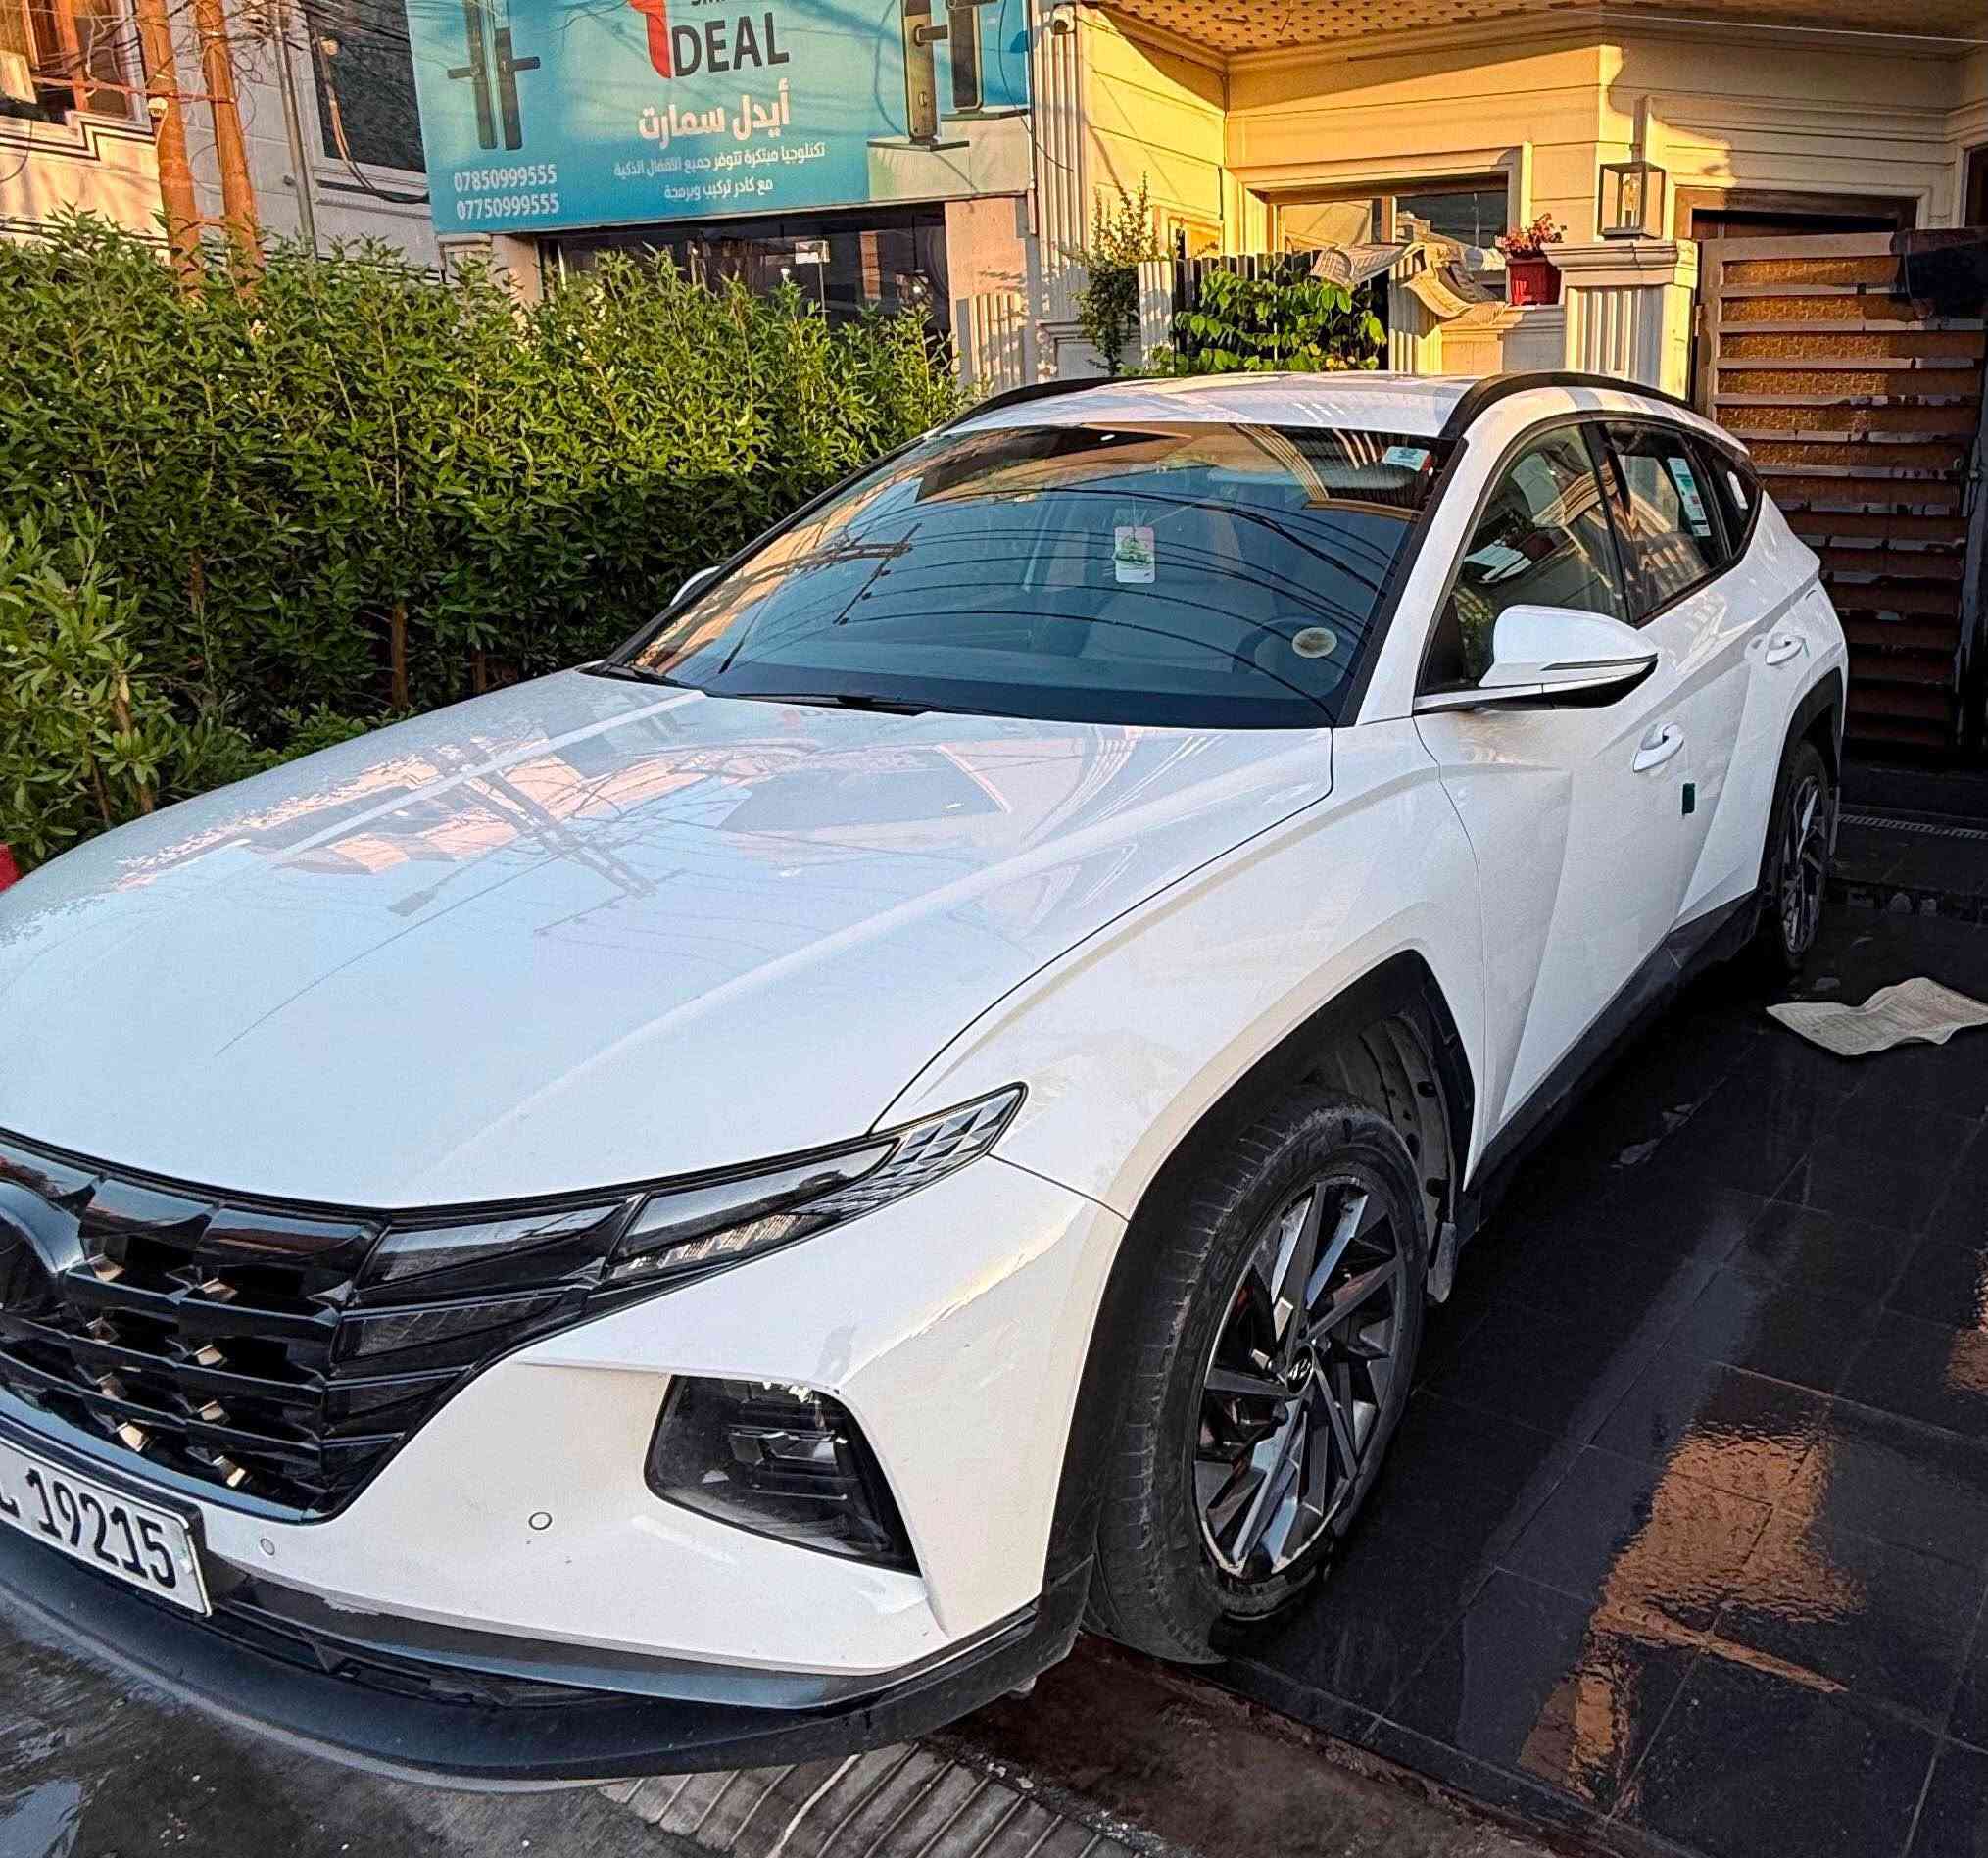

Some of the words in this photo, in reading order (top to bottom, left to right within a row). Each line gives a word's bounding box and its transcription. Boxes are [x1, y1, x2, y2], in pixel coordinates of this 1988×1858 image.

[732, 77, 791, 141] أيدل
[638, 102, 726, 150] سمارت
[454, 163, 558, 193] 07850999555
[613, 159, 645, 180] الذكية
[684, 157, 712, 174] جميع
[703, 178, 732, 199] تركيب
[756, 178, 774, 196] مع
[456, 193, 560, 220] 07750999555
[25, 1467, 176, 1589] 19215
